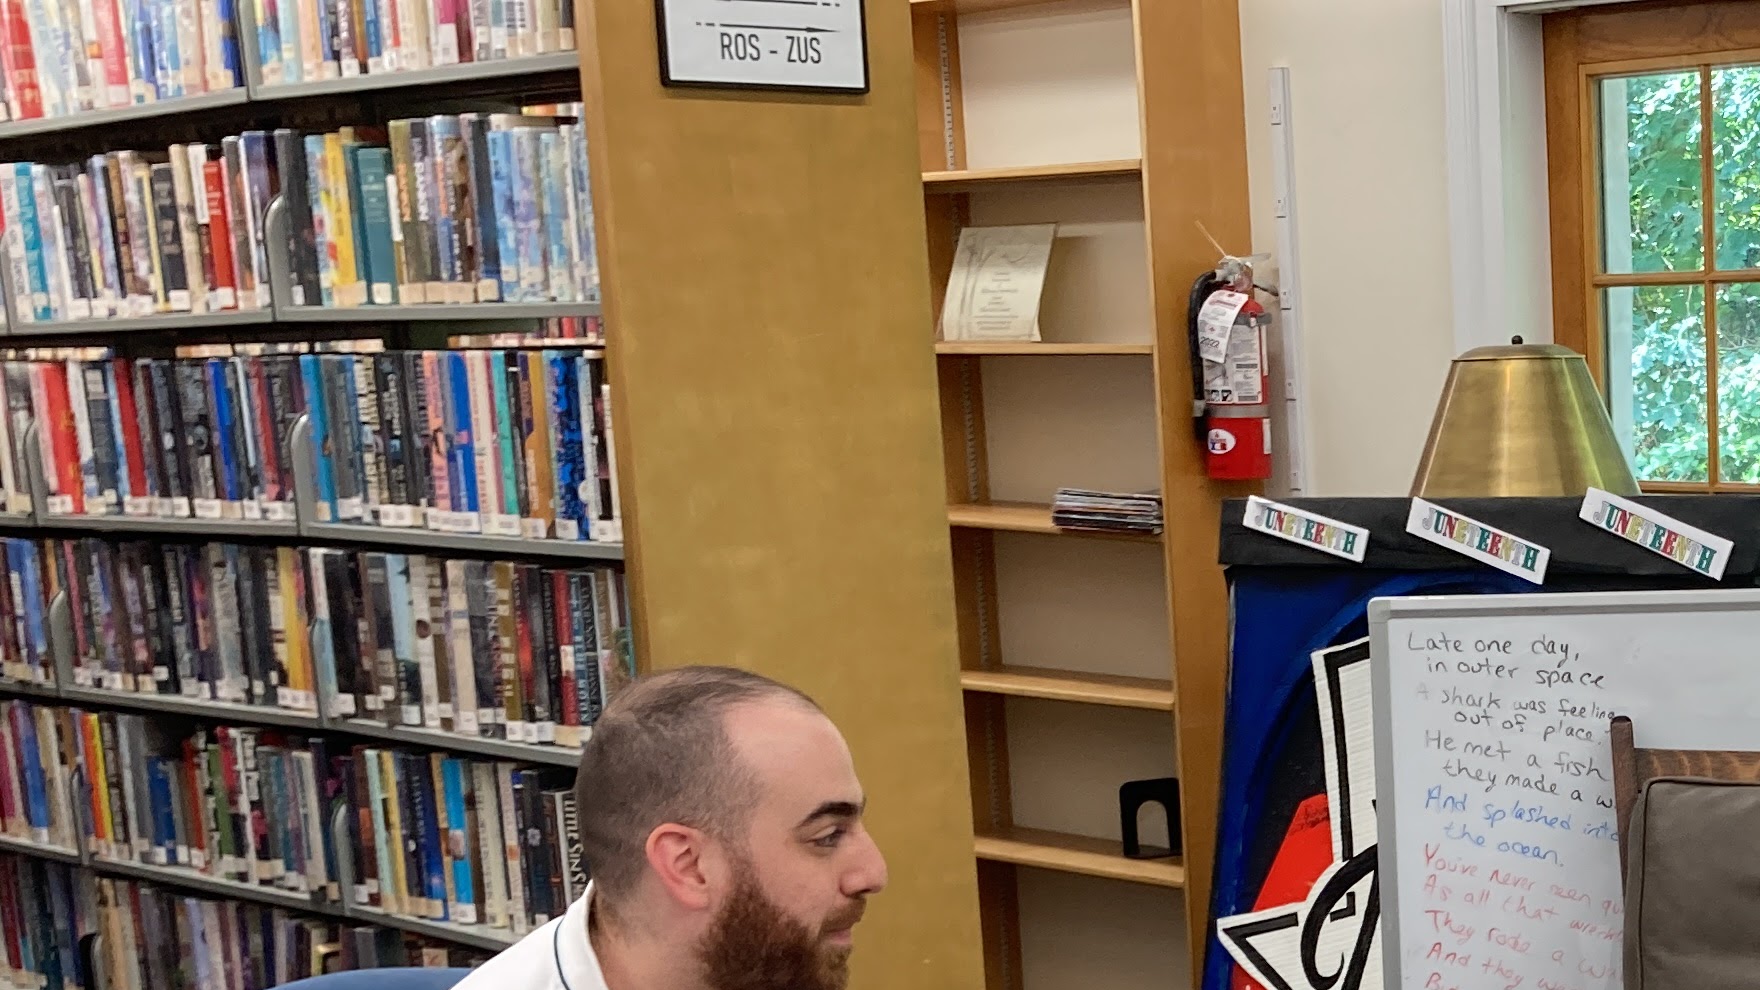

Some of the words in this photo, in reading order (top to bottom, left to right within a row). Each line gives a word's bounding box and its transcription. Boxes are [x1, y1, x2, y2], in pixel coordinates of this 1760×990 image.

[719, 32, 761, 61] ROS
[785, 35, 822, 64] ZUS
[1254, 502, 1358, 555] JUNETEENTH
[1421, 507, 1540, 573] JUNETEENTH
[1592, 500, 1718, 574] JUNETEENTH
[1407, 631, 1463, 653] Late
[1474, 638, 1513, 655] one
[1530, 634, 1580, 668] day,
[1426, 657, 1448, 673] in
[1456, 657, 1519, 679] outer
[1535, 669, 1607, 689] space
[1453, 708, 1494, 726] out
[1501, 713, 1528, 733] of
[1512, 699, 1548, 715] was
[1423, 728, 1457, 753] He
[1463, 739, 1513, 762] met
[1526, 754, 1543, 769] a
[1553, 751, 1612, 782] fish
[1442, 758, 1498, 793] they
[1504, 772, 1561, 797] made
[1570, 789, 1584, 803] a
[1424, 784, 1468, 813] And
[1482, 799, 1573, 829] splashed
[1443, 821, 1486, 847] the
[1463, 889, 1491, 906] all
[1501, 895, 1561, 921] that
[1488, 869, 1537, 892] never
[1550, 883, 1592, 907] seen
[1601, 899, 1624, 917] qu
[1423, 908, 1476, 947] They
[1551, 949, 1565, 965] a
[1425, 941, 1470, 967] And
